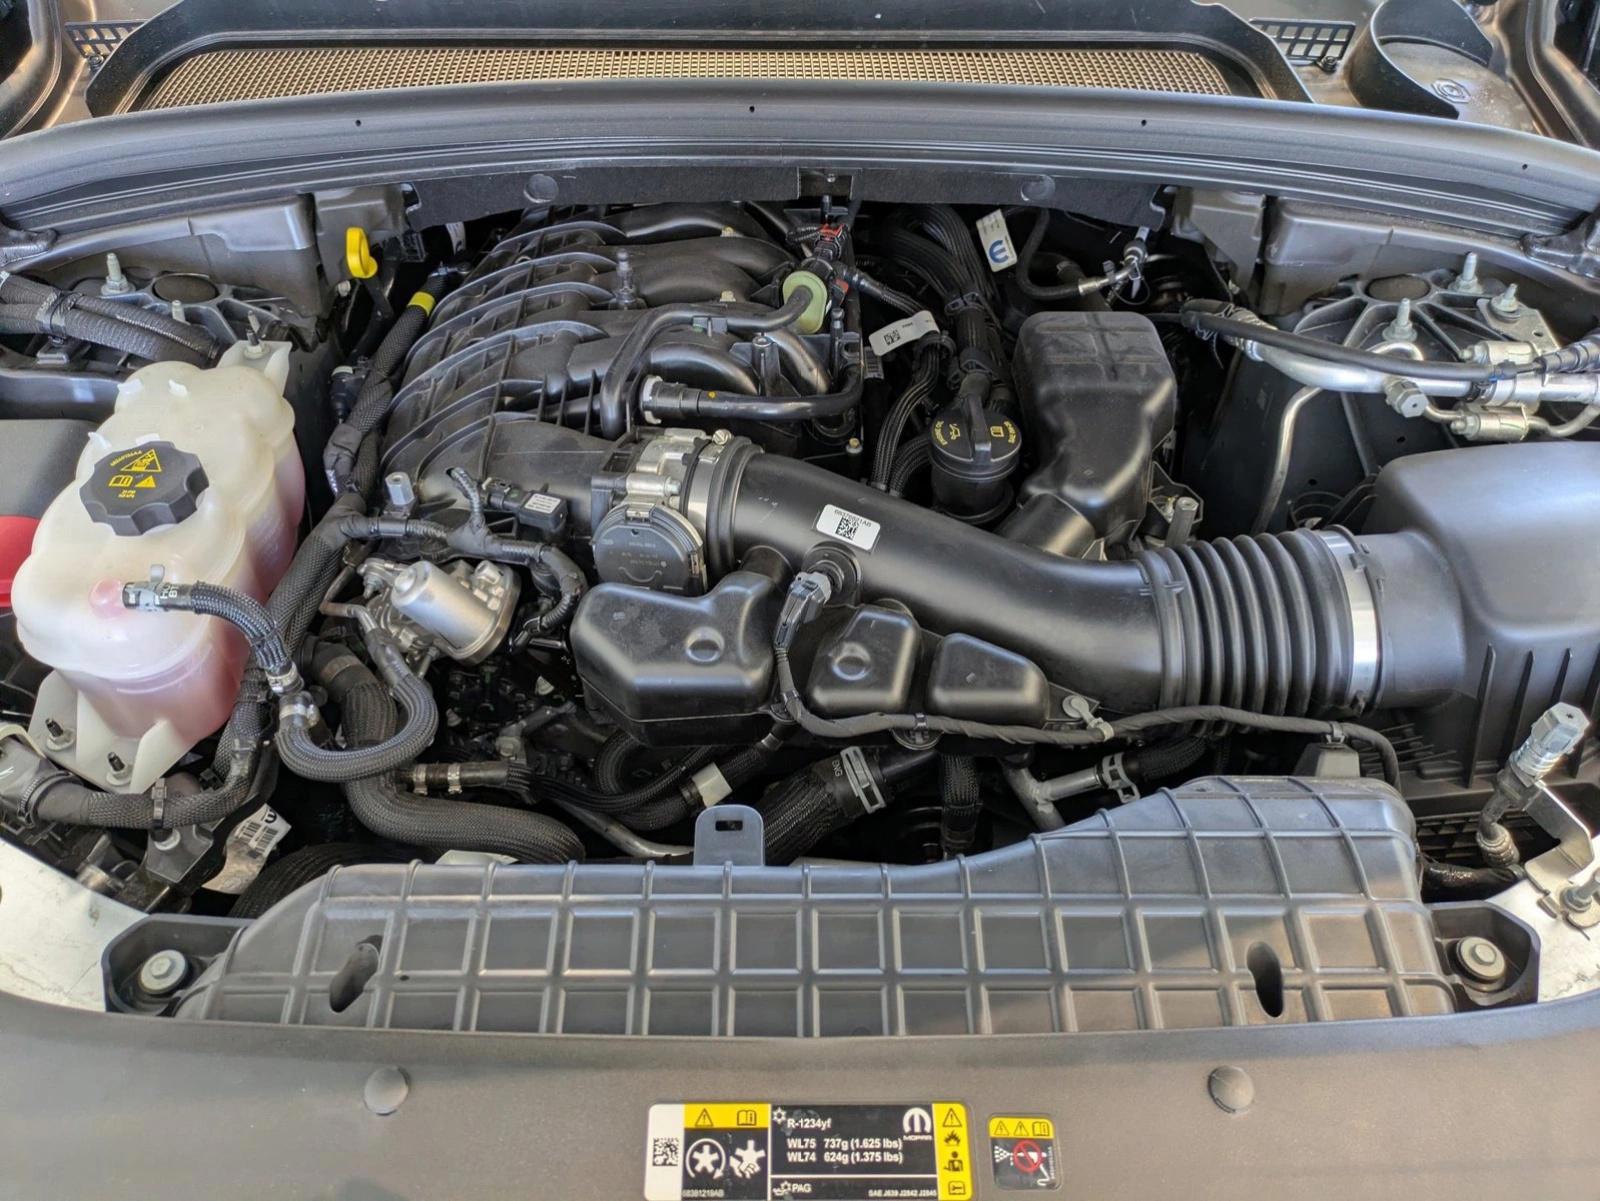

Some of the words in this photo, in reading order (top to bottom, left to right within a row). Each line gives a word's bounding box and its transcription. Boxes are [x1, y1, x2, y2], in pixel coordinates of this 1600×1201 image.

[787, 1118, 832, 1130] R-1234yf
[787, 1138, 816, 1149] WL75
[824, 1138, 849, 1151] 737g
[851, 1138, 881, 1151] (1.625
[883, 1138, 903, 1151] lbs)
[787, 1152, 816, 1162] WL74
[824, 1152, 849, 1165] 624g
[851, 1152, 882, 1165] (1.375
[883, 1152, 903, 1165] lbs)
[792, 1184, 812, 1193] PAG
